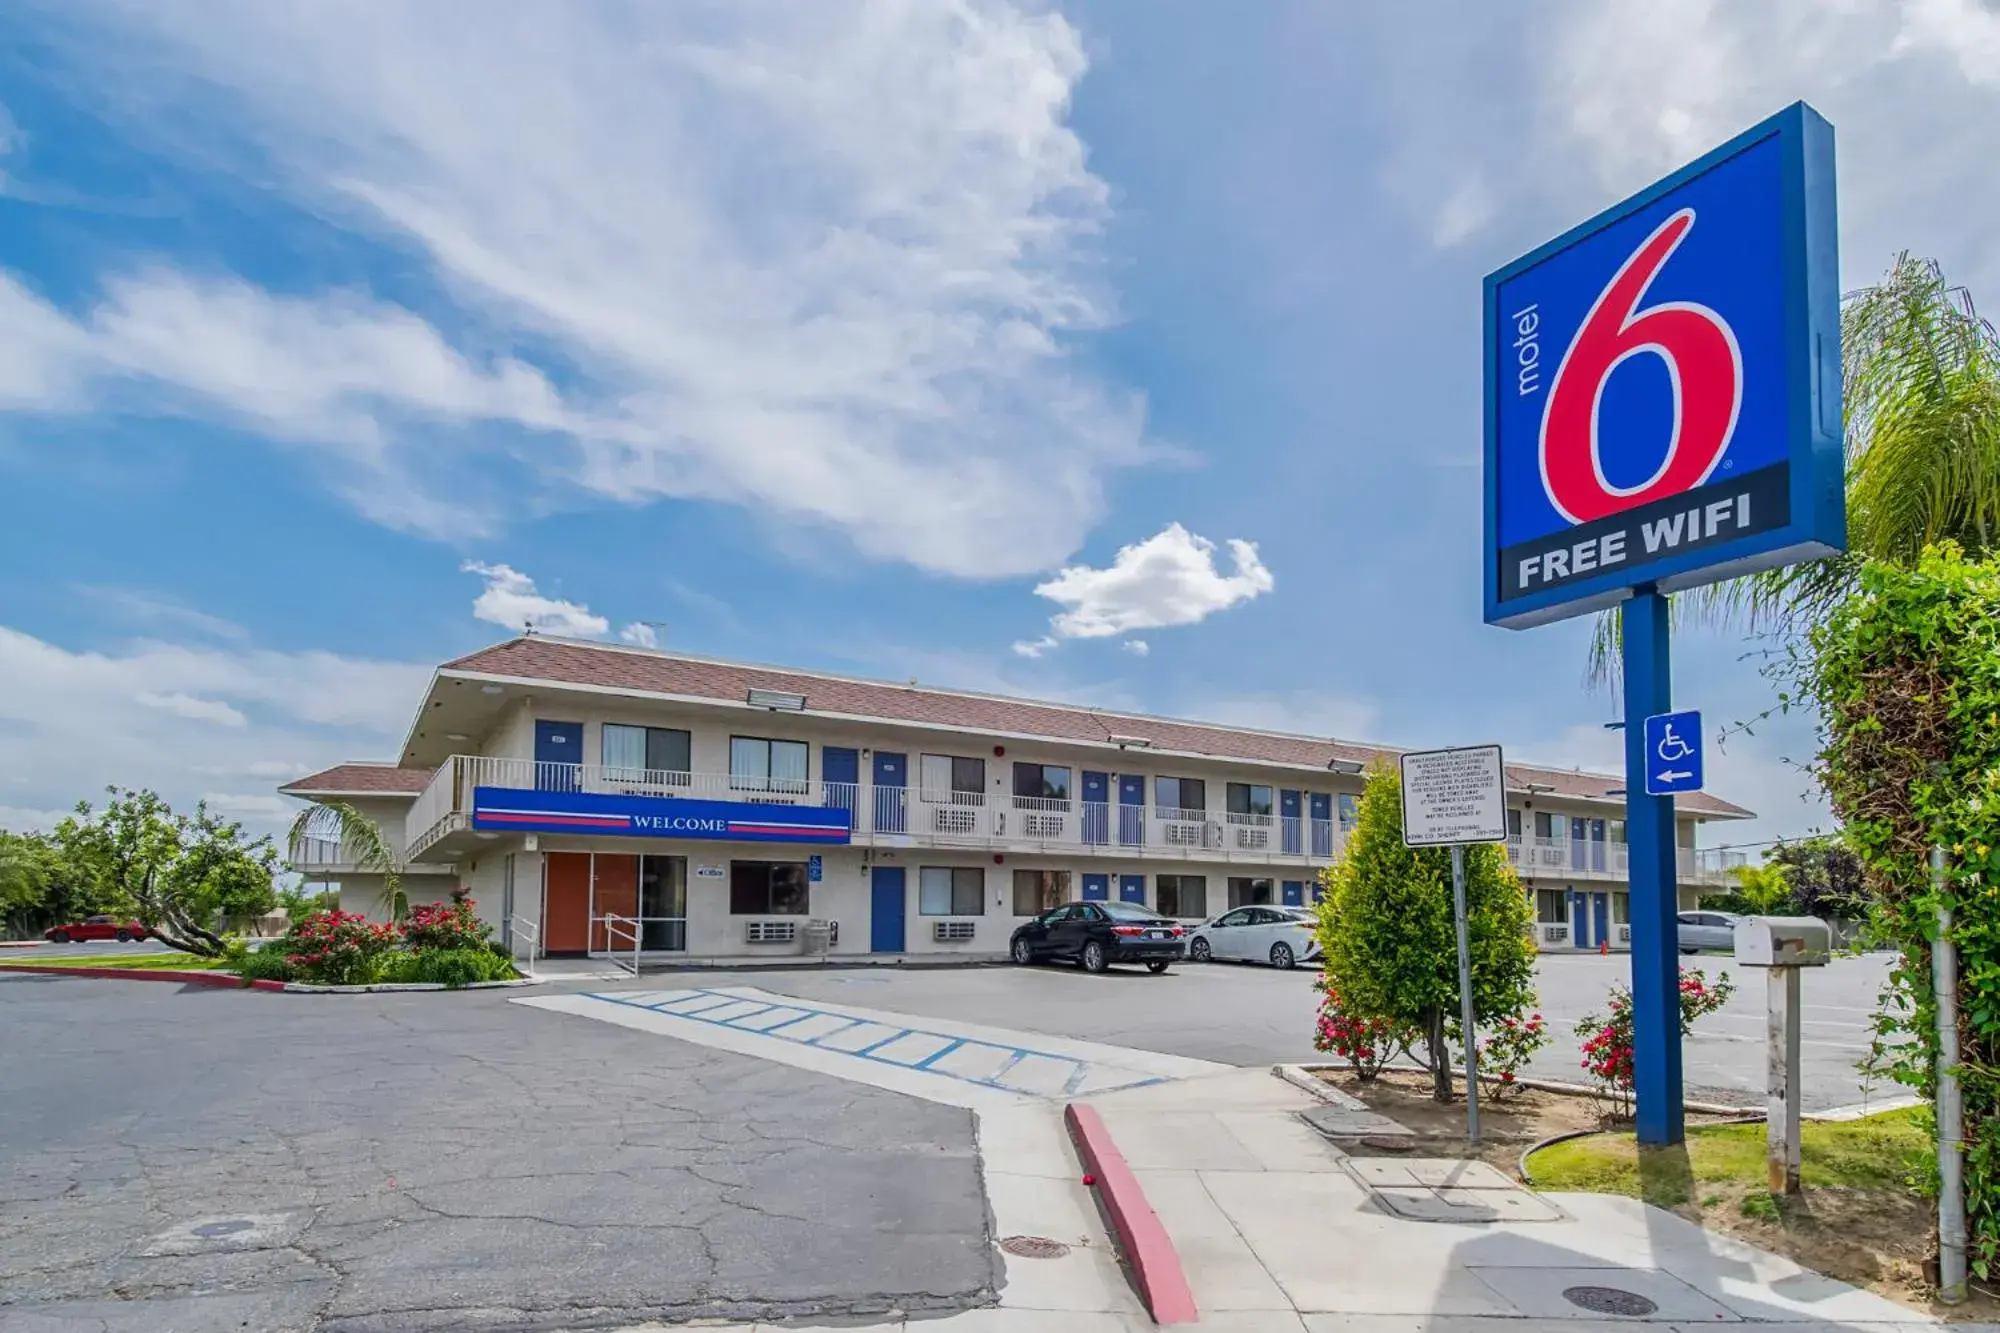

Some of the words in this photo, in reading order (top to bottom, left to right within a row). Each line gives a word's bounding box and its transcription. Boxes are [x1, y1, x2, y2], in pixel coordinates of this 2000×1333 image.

[1512, 303, 1539, 395] motel
[1538, 207, 1743, 526] 6
[1519, 530, 1626, 589] FREE
[1641, 493, 1750, 553] WIFI
[634, 815, 726, 831] WELCOME
